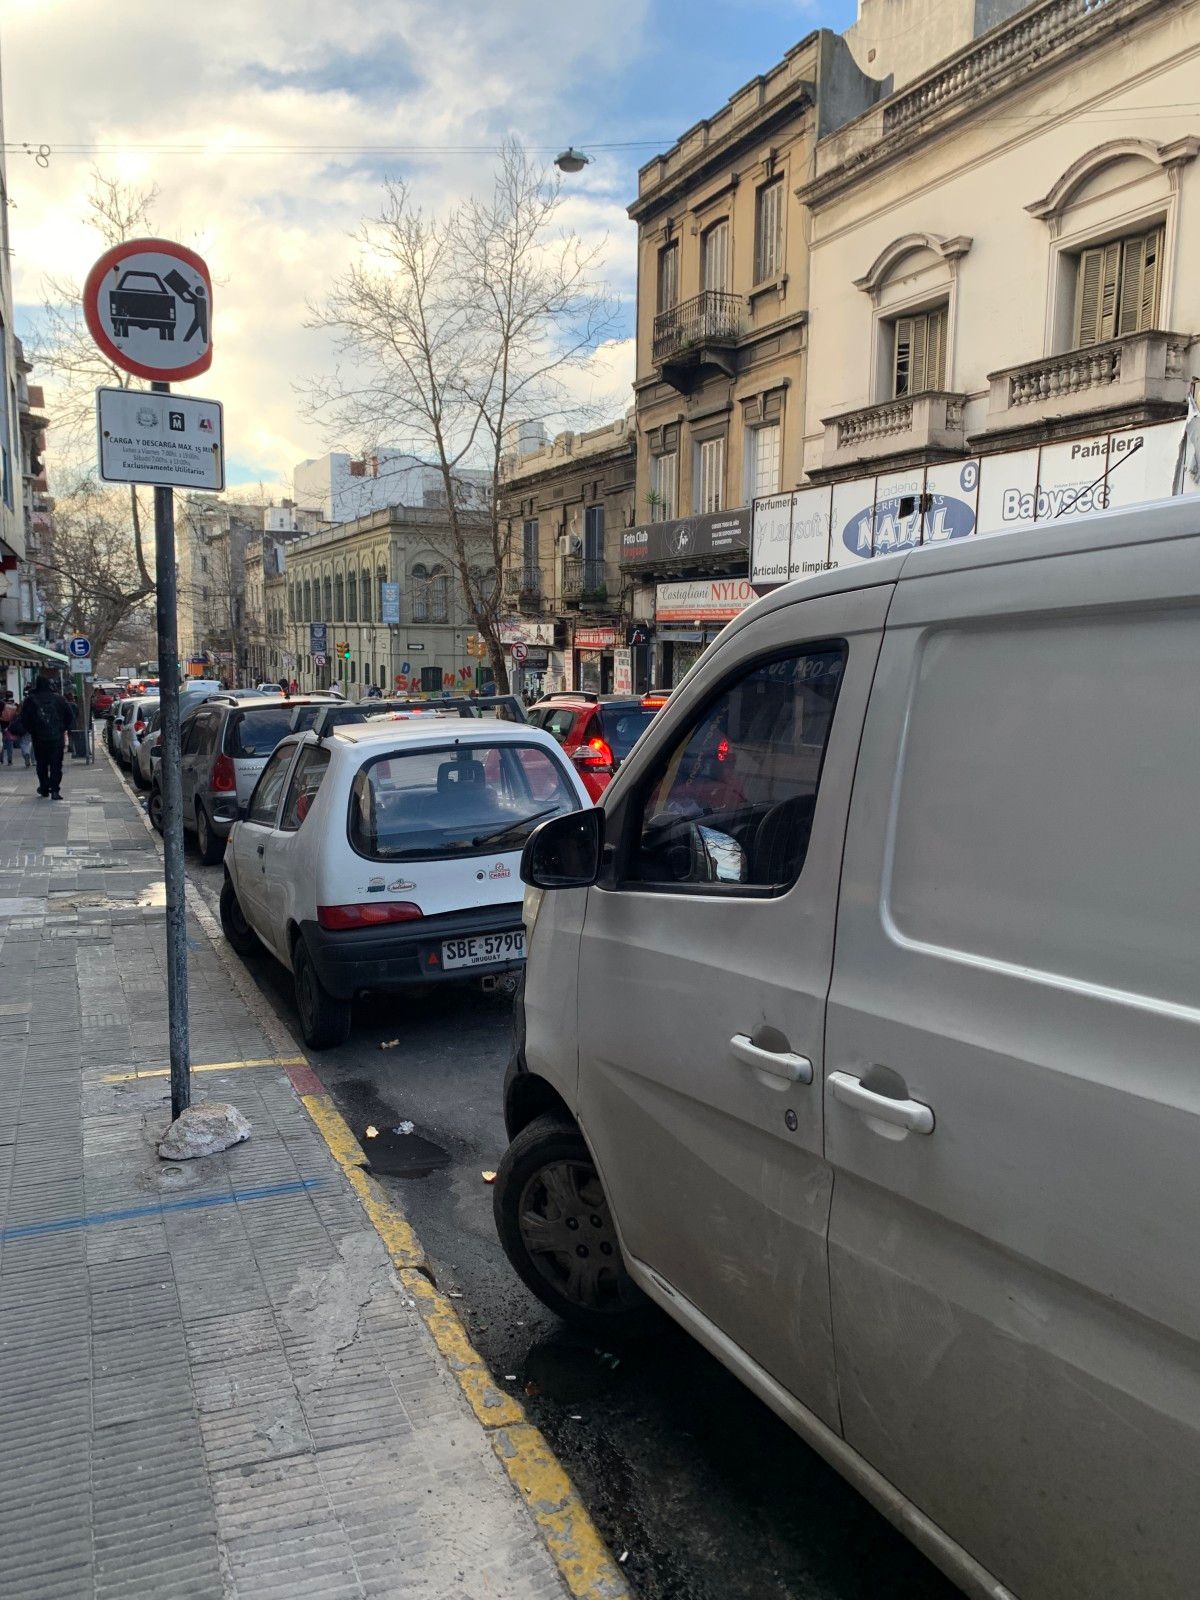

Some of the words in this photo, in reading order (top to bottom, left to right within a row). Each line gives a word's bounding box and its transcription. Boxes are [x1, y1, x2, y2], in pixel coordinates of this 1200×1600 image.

[109, 436, 133, 445] CARGA
[142, 439, 176, 449] DESCARGA
[195, 446, 202, 454] 15
[1071, 436, 1144, 459] Pañalera
[122, 461, 174, 472] Exclusivamente
[174, 464, 205, 475] Utilitarios
[963, 466, 976, 488] 9
[877, 480, 918, 499] Cadena
[755, 497, 798, 512] Perfumera
[1002, 484, 1112, 521] Babysec
[623, 533, 636, 545] Foto
[636, 530, 648, 543] Club
[857, 507, 953, 551] NATAL
[789, 562, 800, 574] de
[802, 559, 839, 573] limpieza
[74, 639, 85, 652] E
[447, 940, 478, 960] SBE
[484, 933, 524, 955] 5790
[471, 953, 501, 964] URUGUAY
